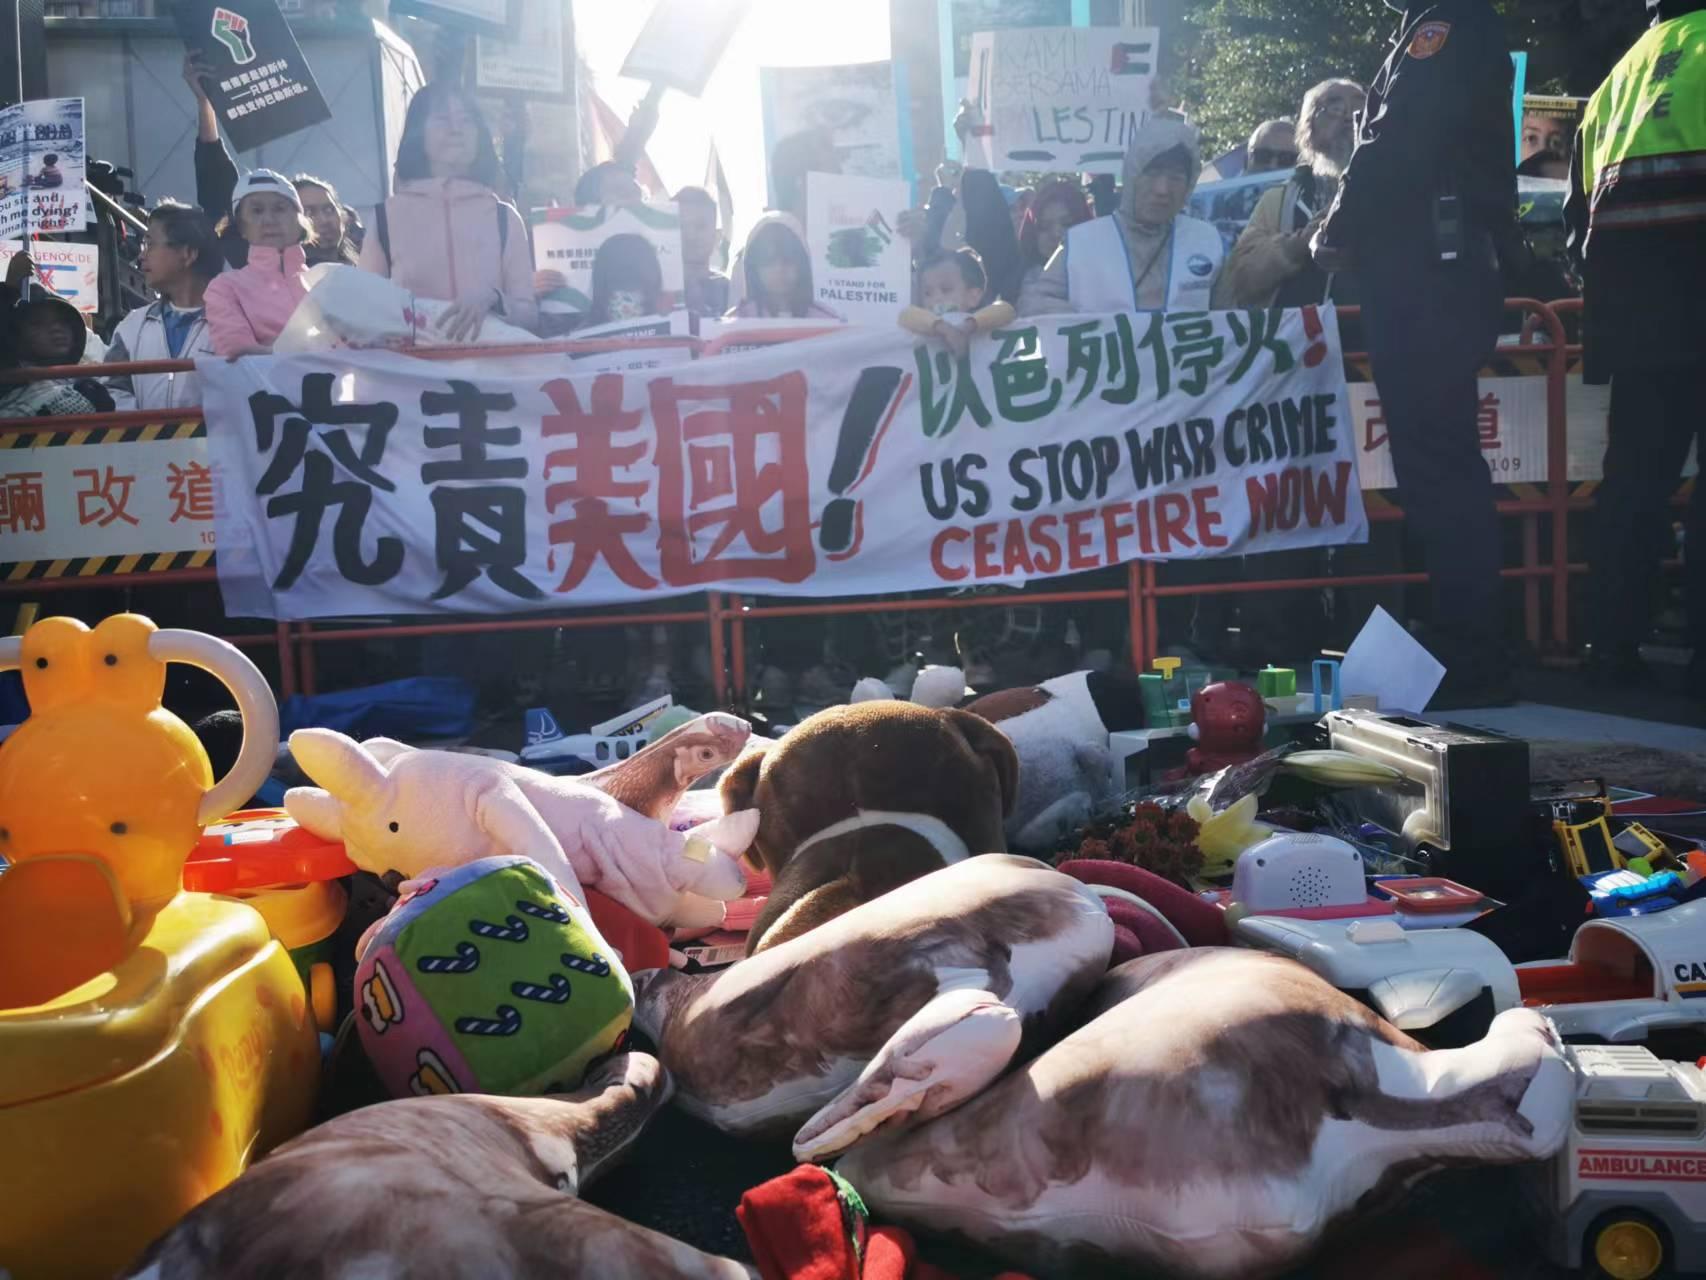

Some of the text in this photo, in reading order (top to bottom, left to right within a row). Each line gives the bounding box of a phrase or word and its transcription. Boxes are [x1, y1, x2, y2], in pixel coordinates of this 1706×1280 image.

[33, 192, 59, 203] and
[32, 201, 79, 218] dying?
[32, 218, 76, 230] rights?
[34, 251, 92, 263] GENOCIDE
[834, 280, 865, 288] STAND
[867, 281, 886, 289] FOR
[820, 288, 898, 303] PALESTINE
[920, 393, 1338, 521] US STOP WAR CRIME
[930, 462, 1352, 582] CEASEFIRE NOW
[1578, 1156, 1706, 1175] AMBULANCE
